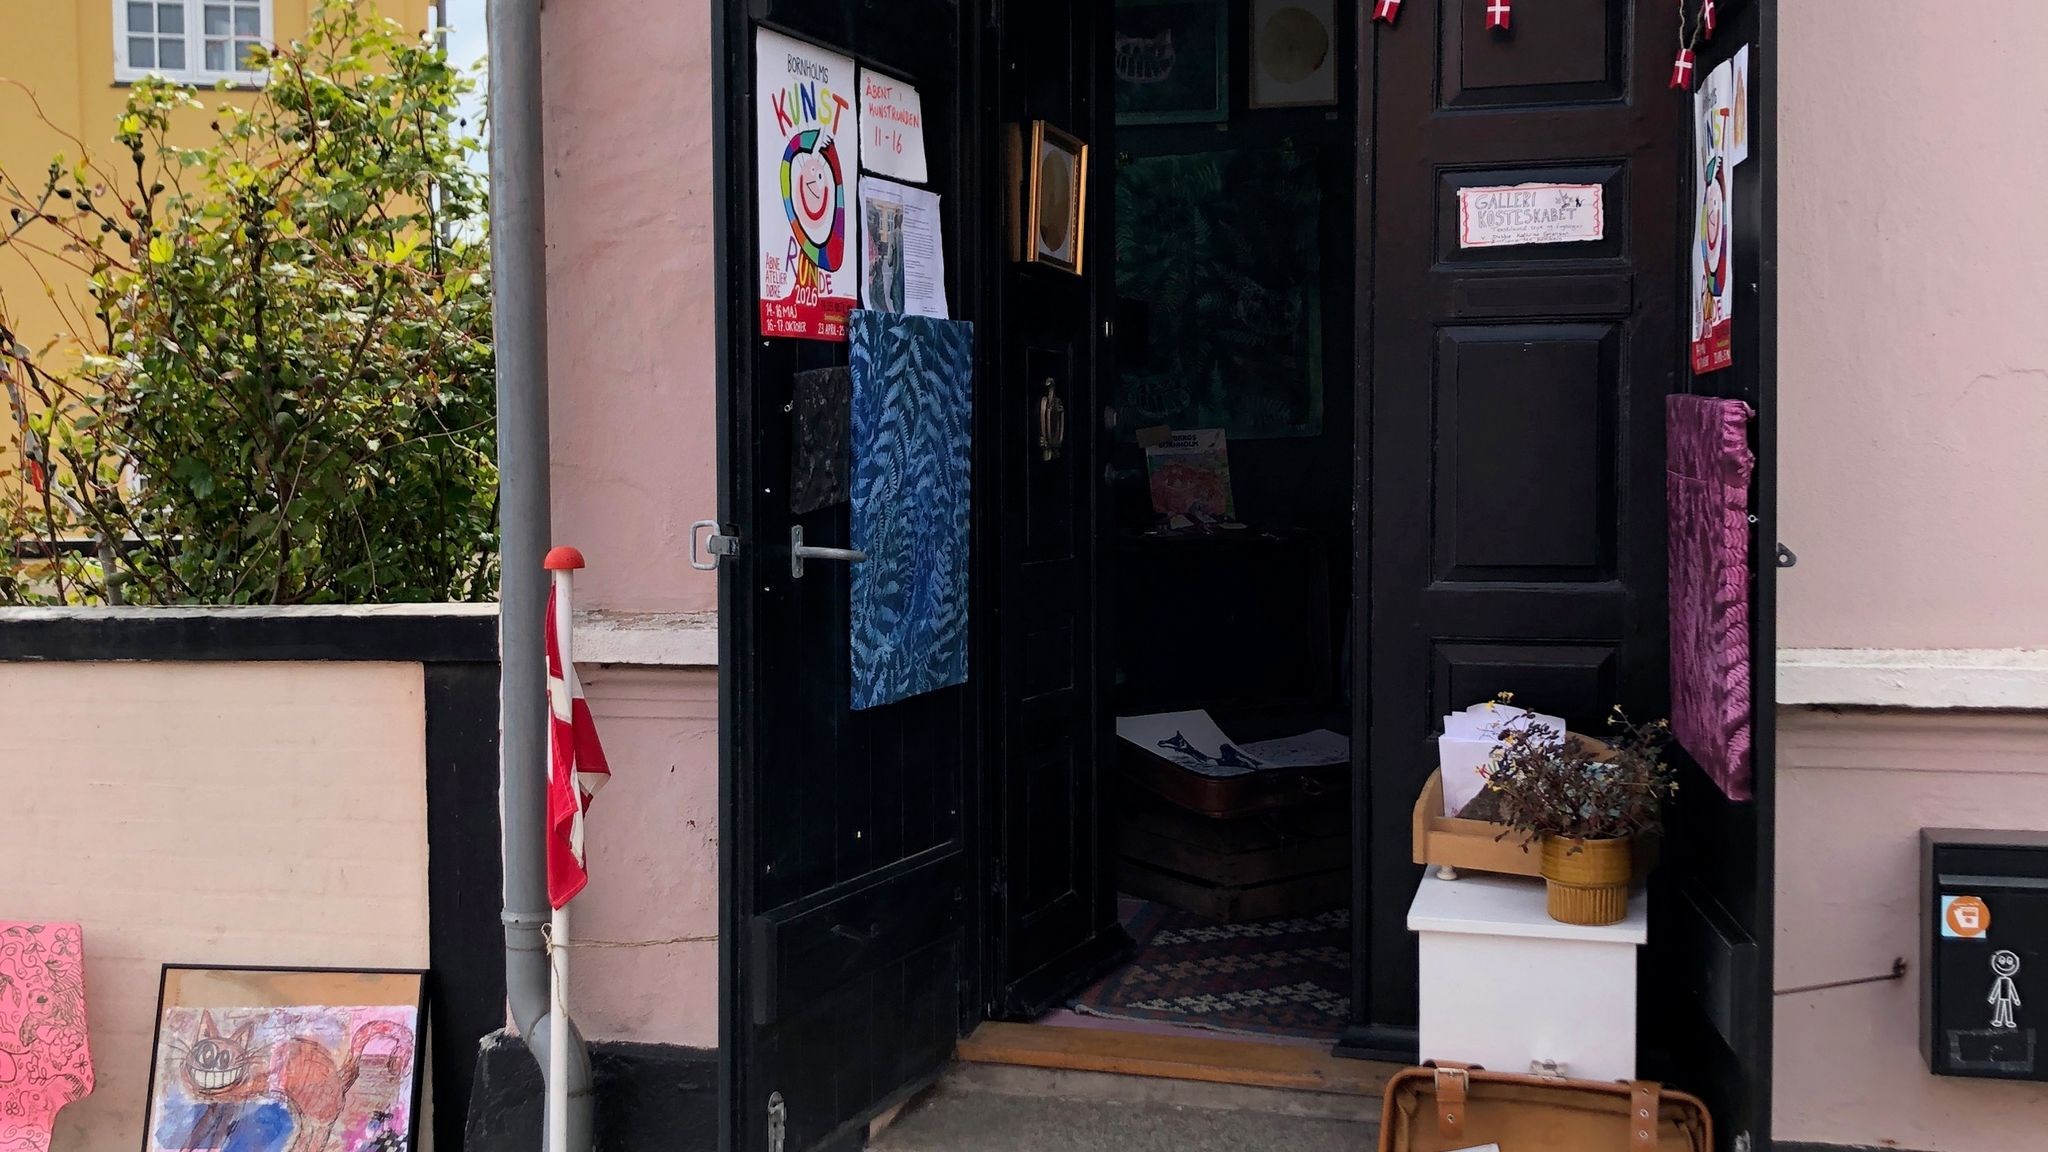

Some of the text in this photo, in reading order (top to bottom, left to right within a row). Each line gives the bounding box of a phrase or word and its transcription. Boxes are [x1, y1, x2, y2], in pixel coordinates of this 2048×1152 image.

[787, 53, 829, 84] BORNHOLMS
[866, 77, 893, 100] ÅBENT
[771, 81, 849, 137] KUNST
[868, 103, 920, 128] KUNSTRUNDEN
[1474, 191, 1537, 210] GALLERI
[1477, 208, 1577, 229] KOSTESKABET
[766, 252, 780, 271] ÅBNE
[785, 235, 833, 295] RUNDE
[765, 270, 788, 285] ATELIER
[766, 284, 781, 298] DØRE
[795, 284, 818, 307] 2026
